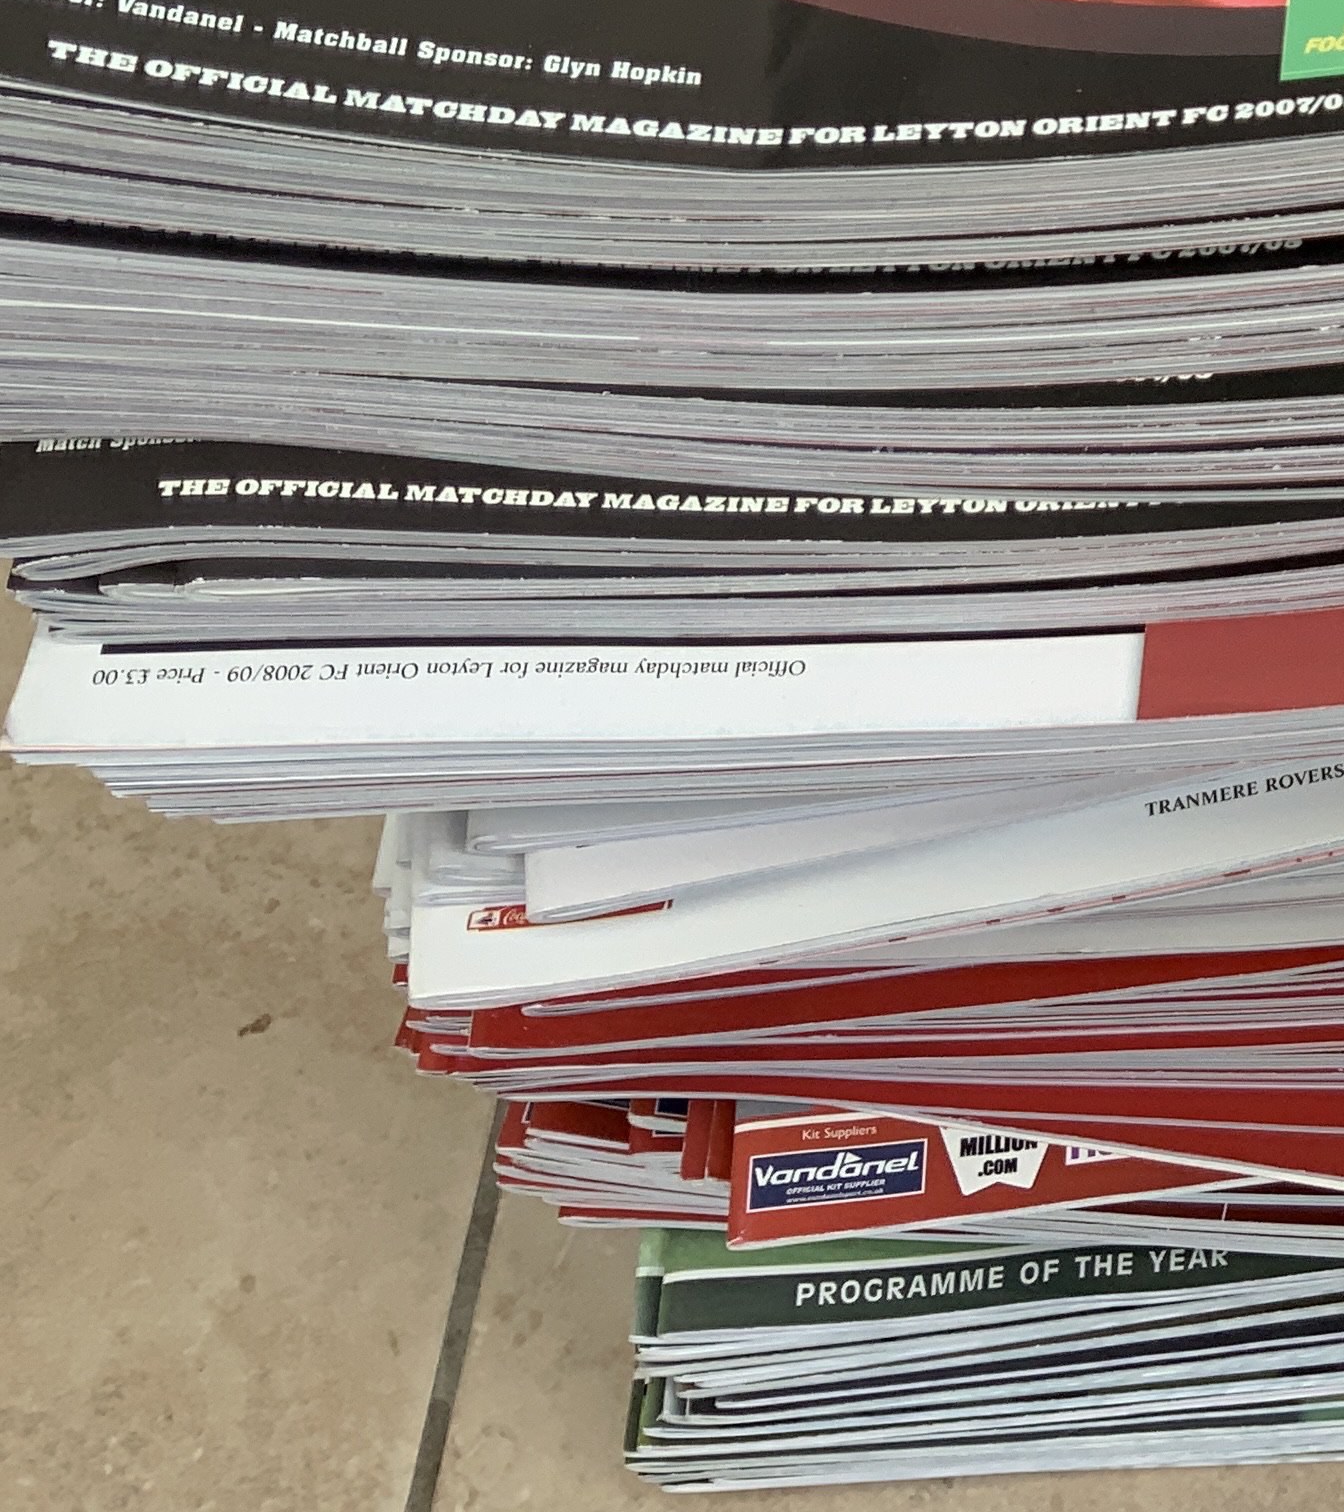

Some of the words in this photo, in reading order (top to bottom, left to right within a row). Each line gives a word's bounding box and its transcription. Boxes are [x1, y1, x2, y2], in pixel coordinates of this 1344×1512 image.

[272, 20, 409, 57] Matchball
[416, 39, 535, 72] Sponsor:
[542, 53, 601, 80] Glyn
[609, 59, 703, 88] Hopkin
[46, 38, 140, 74] THE
[142, 57, 339, 106] OFFICIAL
[342, 87, 568, 131] MATCHDAY
[568, 112, 785, 148] MAGAZINE
[785, 124, 867, 147] FOR
[871, 118, 1029, 144] LEYTON
[1030, 108, 1178, 137] ORIENT
[1179, 101, 1231, 125] FC
[157, 478, 231, 500] THE
[234, 477, 400, 502] OFFICIAL
[403, 483, 599, 509] MATCHDAY
[599, 491, 790, 515] MAGAZINE
[793, 494, 866, 515] FOR
[868, 496, 1007, 516] LEYTON
[91, 666, 151, 686] £3.00
[155, 666, 205, 685] Price
[226, 662, 313, 684] 2008/09
[318, 661, 352, 681] FC
[355, 660, 420, 681] Orient
[424, 659, 494, 680] Leyton
[498, 658, 530, 679] for
[534, 658, 630, 680] magazine
[634, 659, 730, 680] matchday
[734, 657, 808, 679] Official
[1144, 782, 1260, 818] TRANMERE
[800, 1128, 820, 1143] Kit
[823, 1123, 878, 1143] Suppliers
[753, 1149, 920, 1188] Vandanel
[976, 1157, 1019, 1177] .COM
[795, 1264, 1006, 1307] PROGRAMME
[1019, 1257, 1060, 1285] OF
[1073, 1250, 1134, 1279] THE
[1147, 1247, 1230, 1274] YEAR
